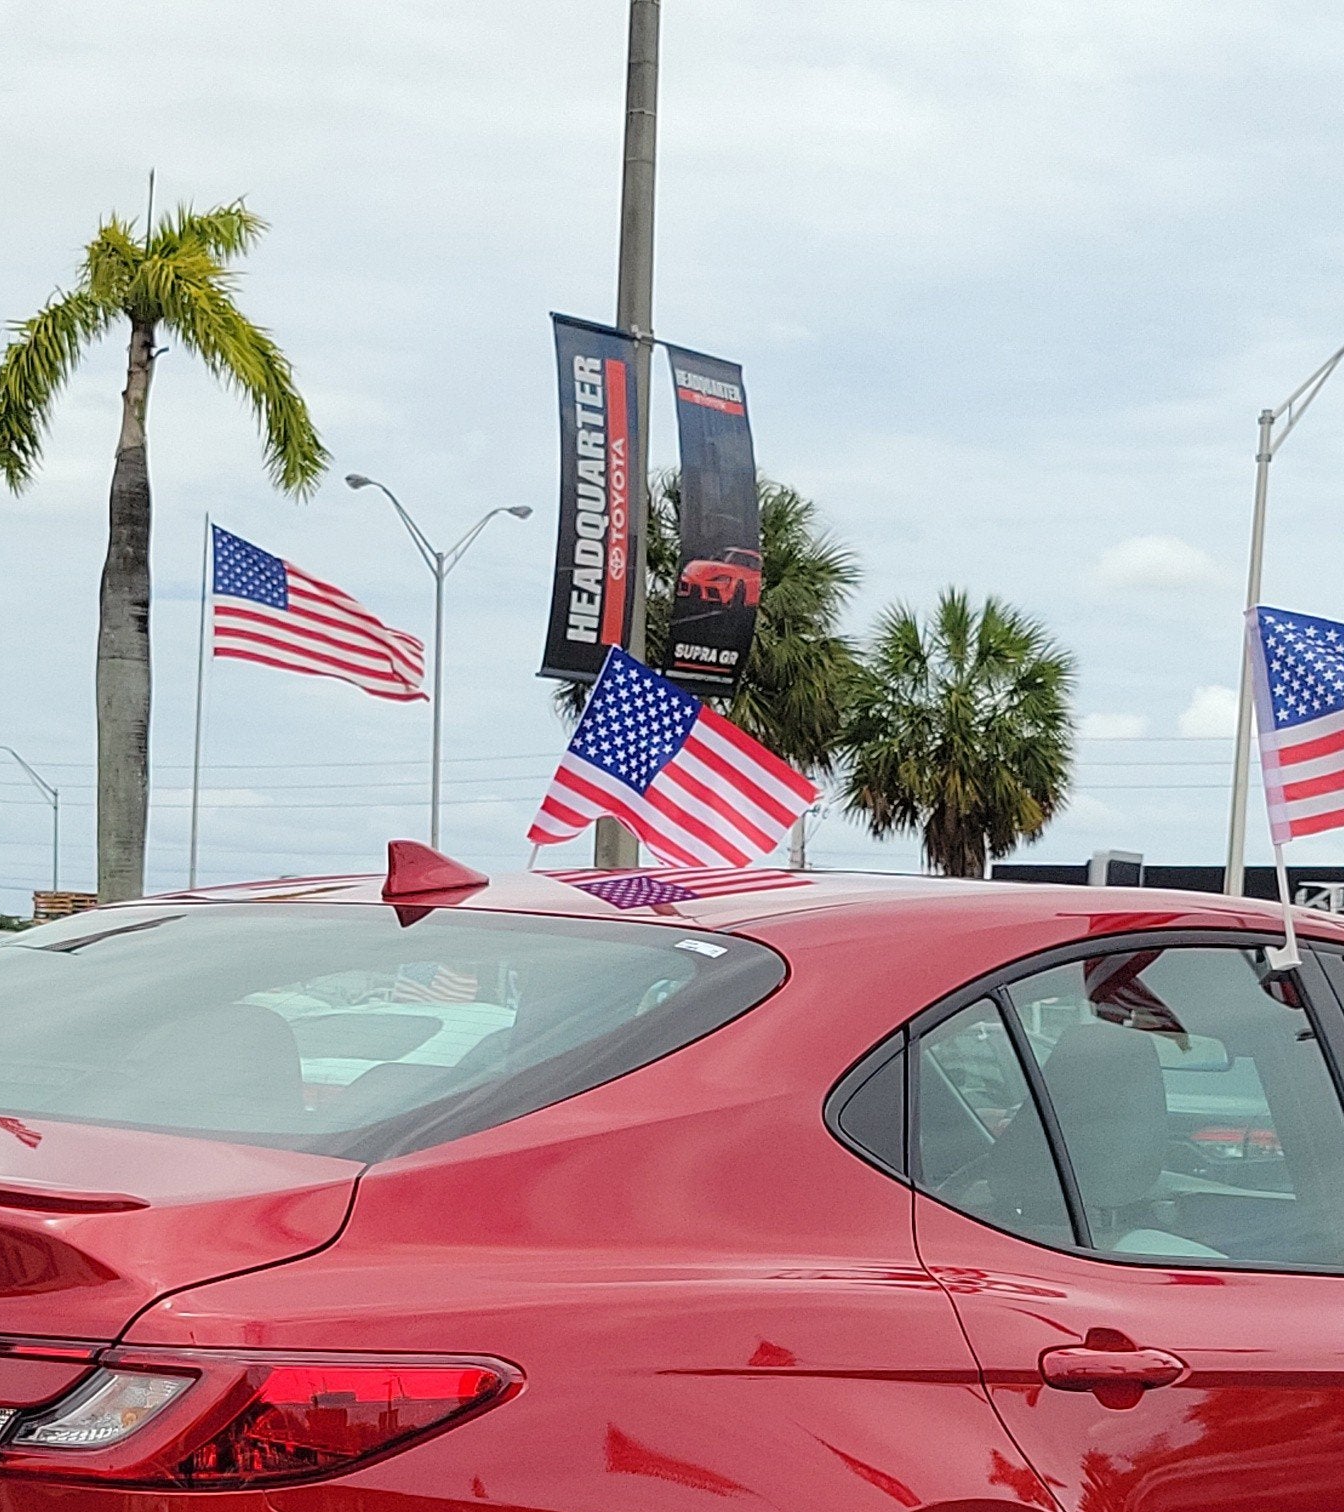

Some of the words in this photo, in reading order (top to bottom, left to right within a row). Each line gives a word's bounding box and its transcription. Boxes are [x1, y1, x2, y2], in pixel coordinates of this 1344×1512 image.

[567, 354, 607, 645] HEADQUARTER
[610, 438, 625, 545] TOYOTA
[674, 642, 718, 663] SUPRA
[719, 649, 739, 666] GR
